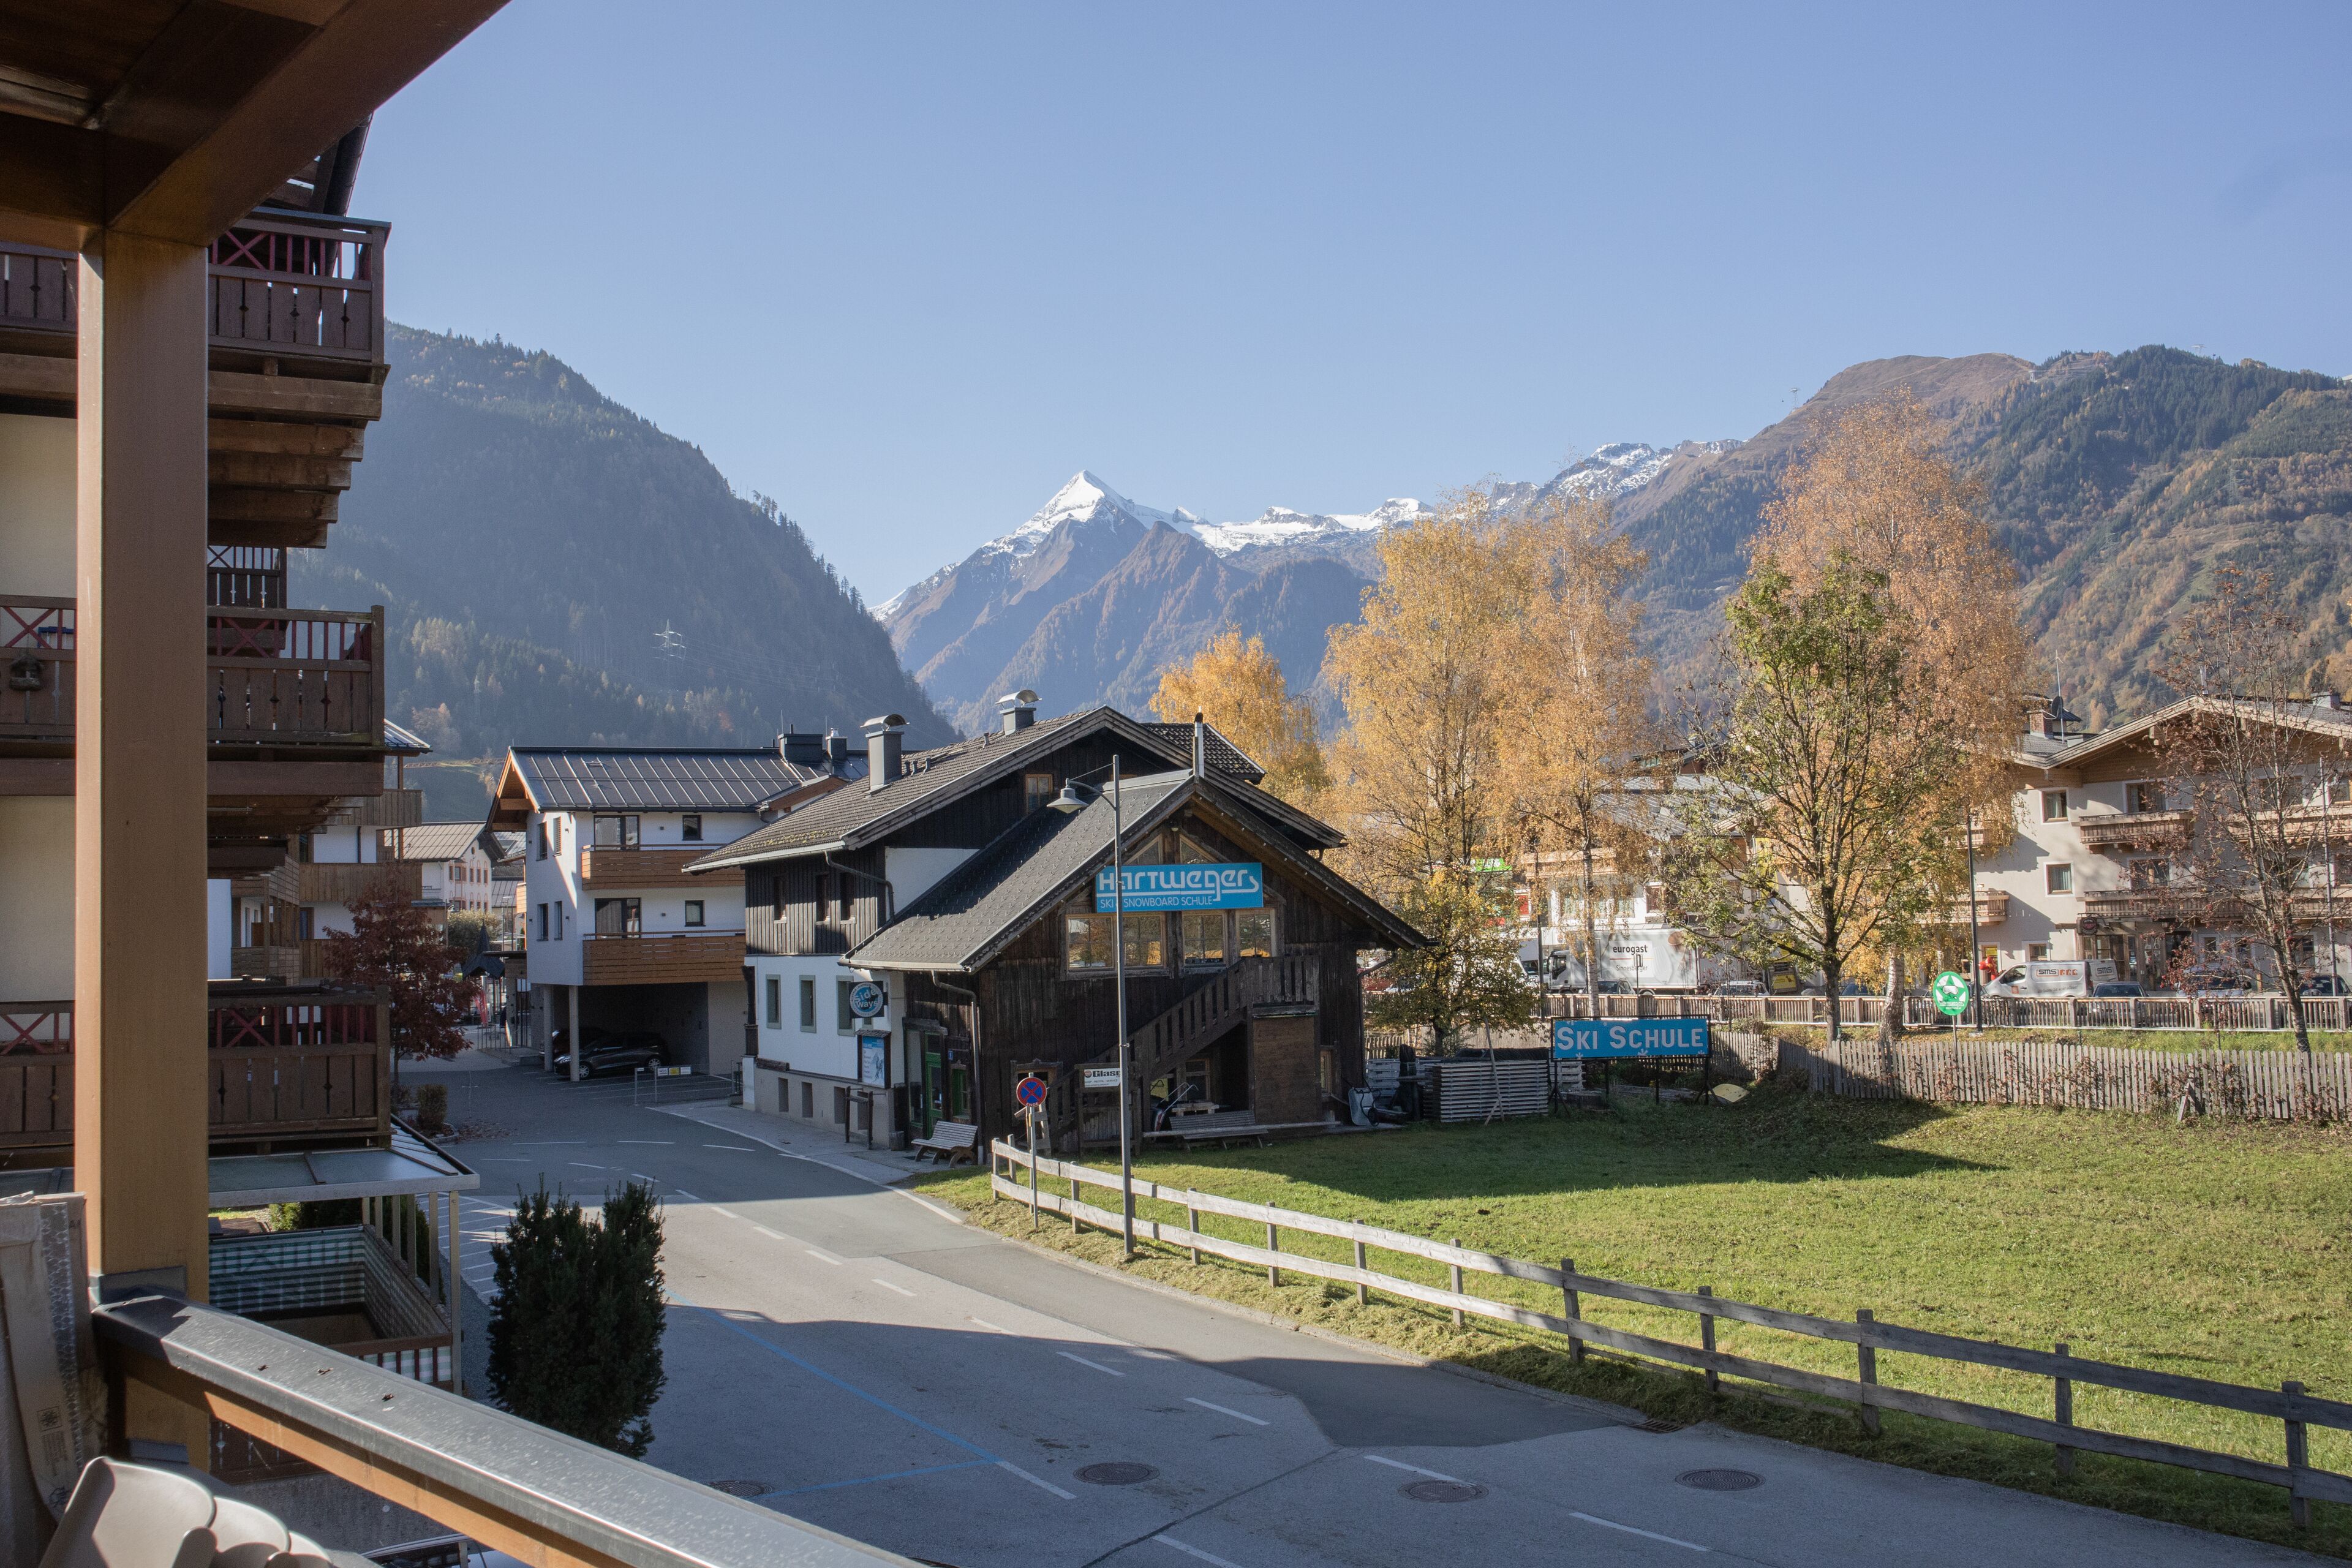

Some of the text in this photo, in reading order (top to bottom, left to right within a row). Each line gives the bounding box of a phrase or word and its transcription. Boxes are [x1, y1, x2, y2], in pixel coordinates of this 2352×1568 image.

[1100, 899, 1114, 908] SKI
[1123, 897, 1180, 907] SNOWBOARD
[1181, 895, 1213, 906] SCHULE
[1613, 945, 1648, 955] eurogast
[1557, 1026, 1703, 1050] SKI SCHULE
